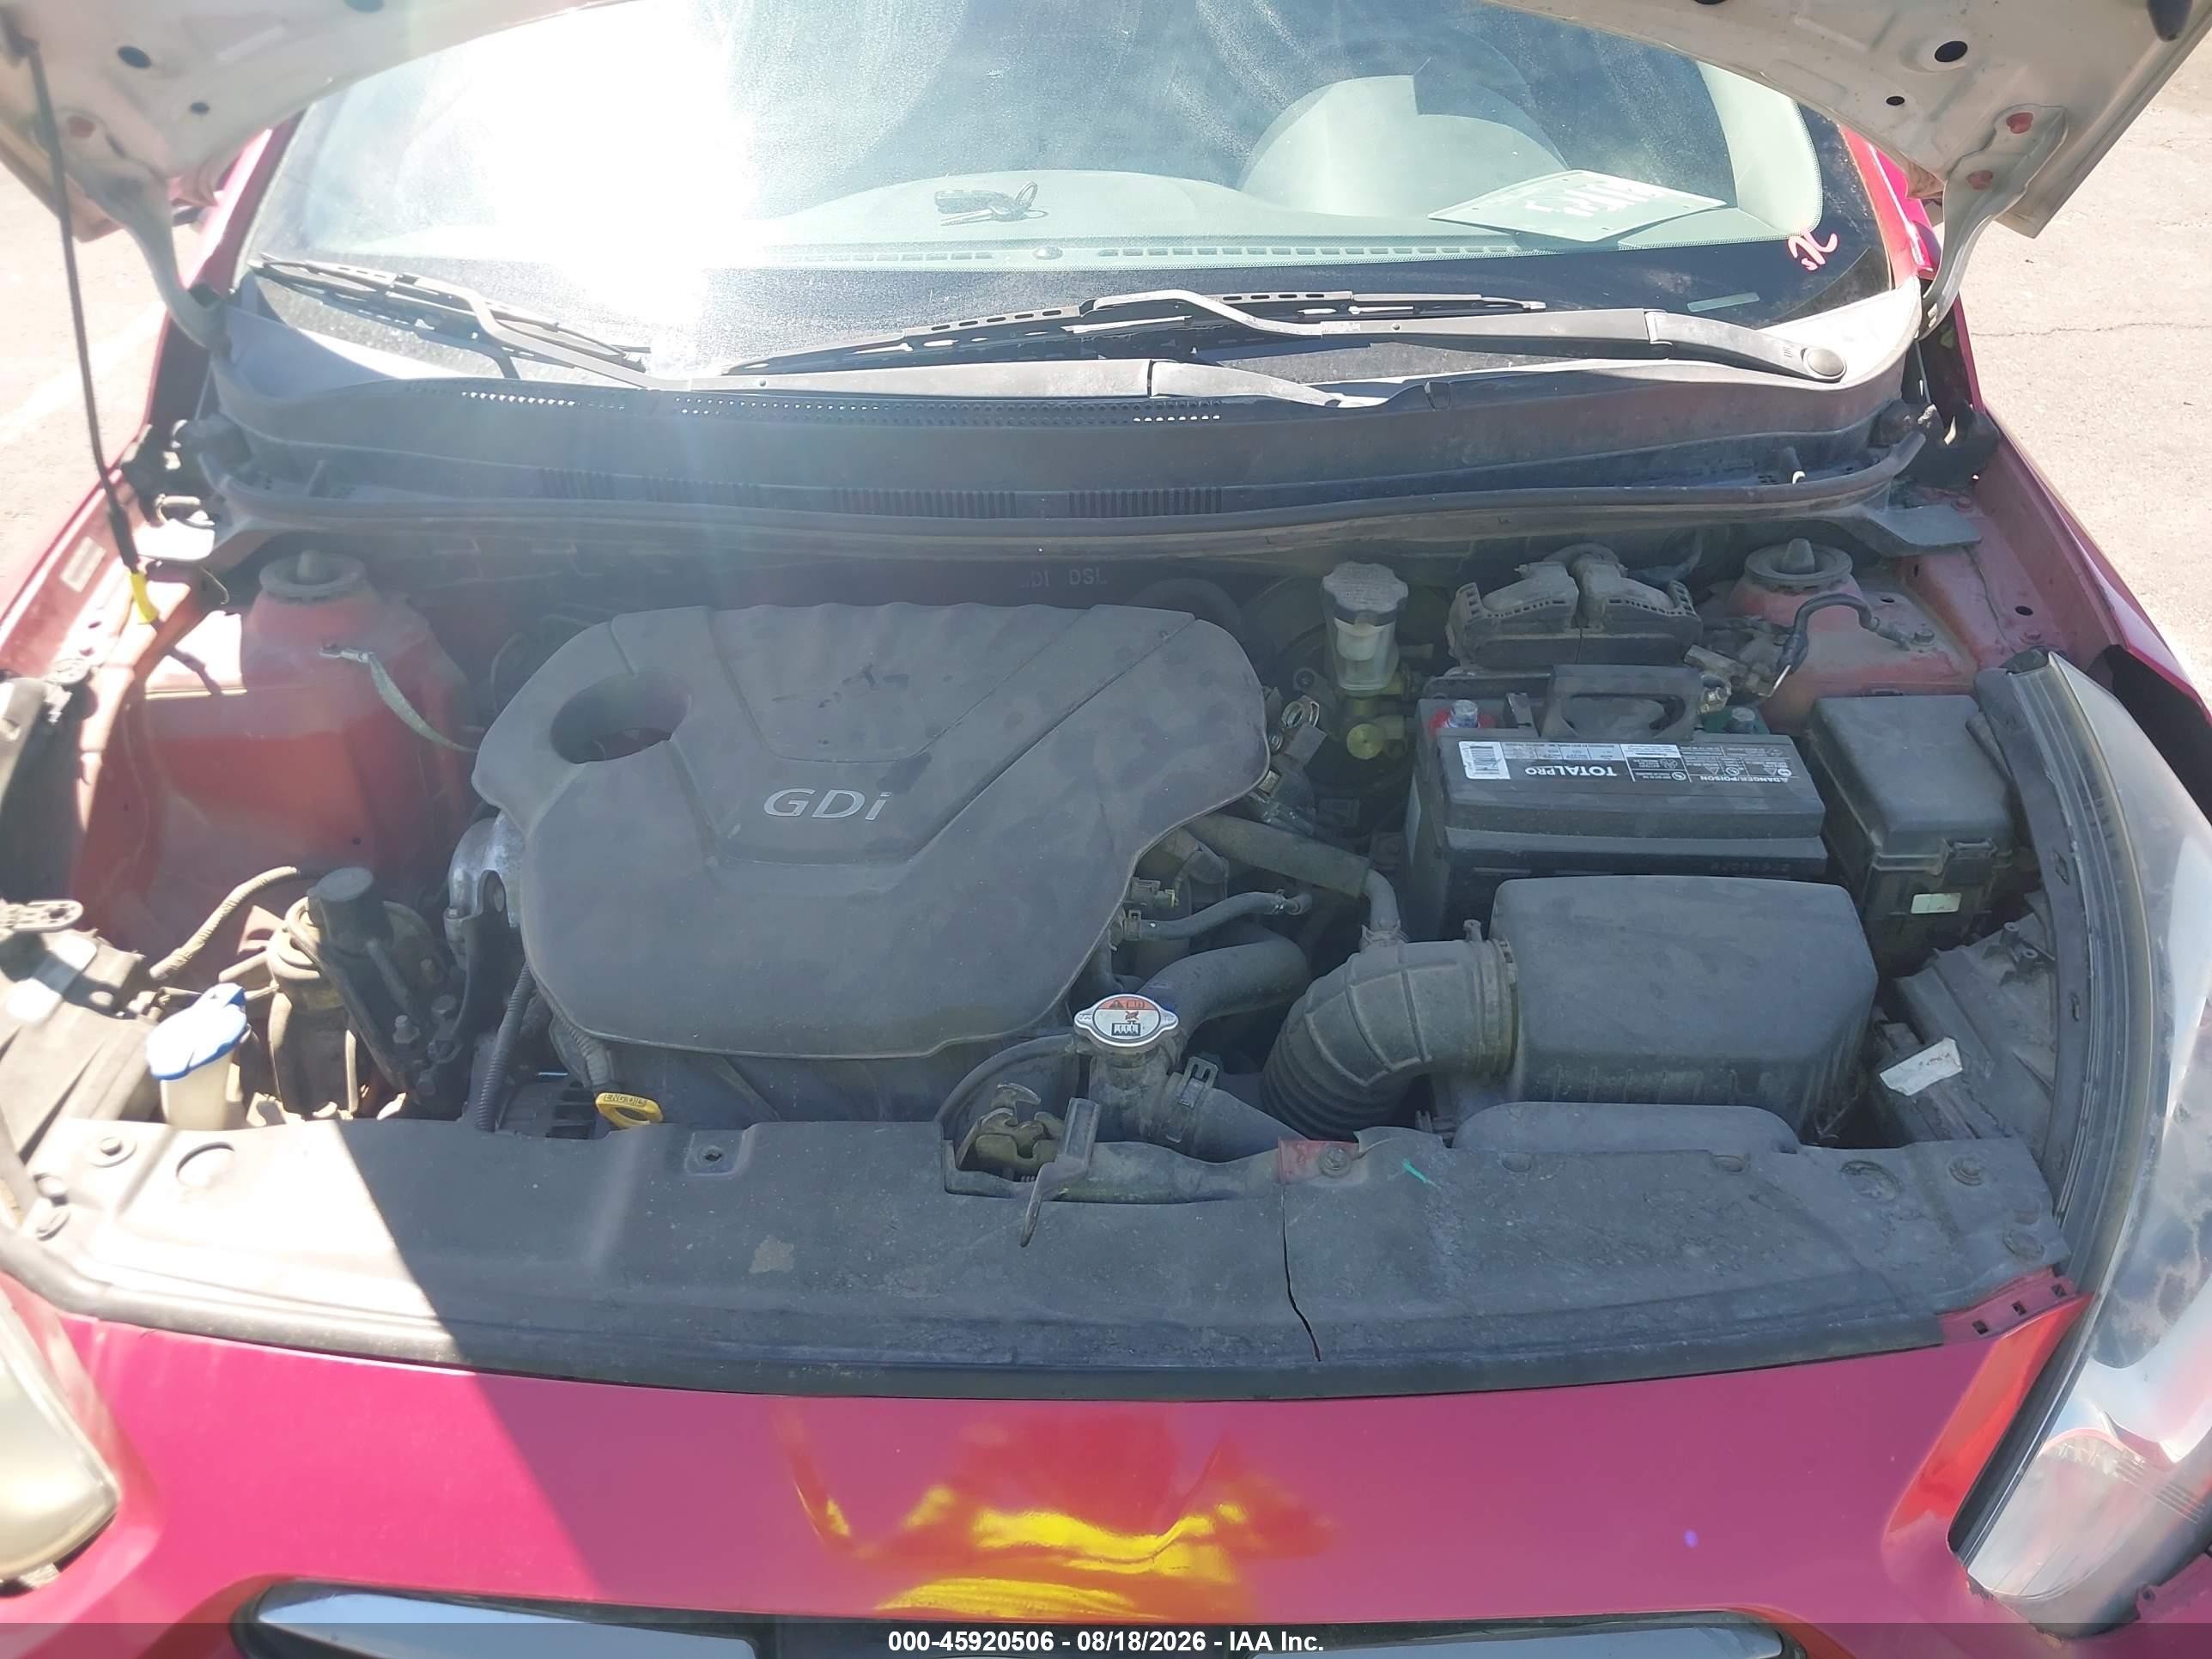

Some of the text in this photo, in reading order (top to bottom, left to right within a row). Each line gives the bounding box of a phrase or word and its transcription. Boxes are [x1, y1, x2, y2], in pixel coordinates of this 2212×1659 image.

[1524, 765, 1618, 777] TOTALPRO
[763, 787, 894, 821] GDi
[605, 1095, 643, 1106] ENG OIL
